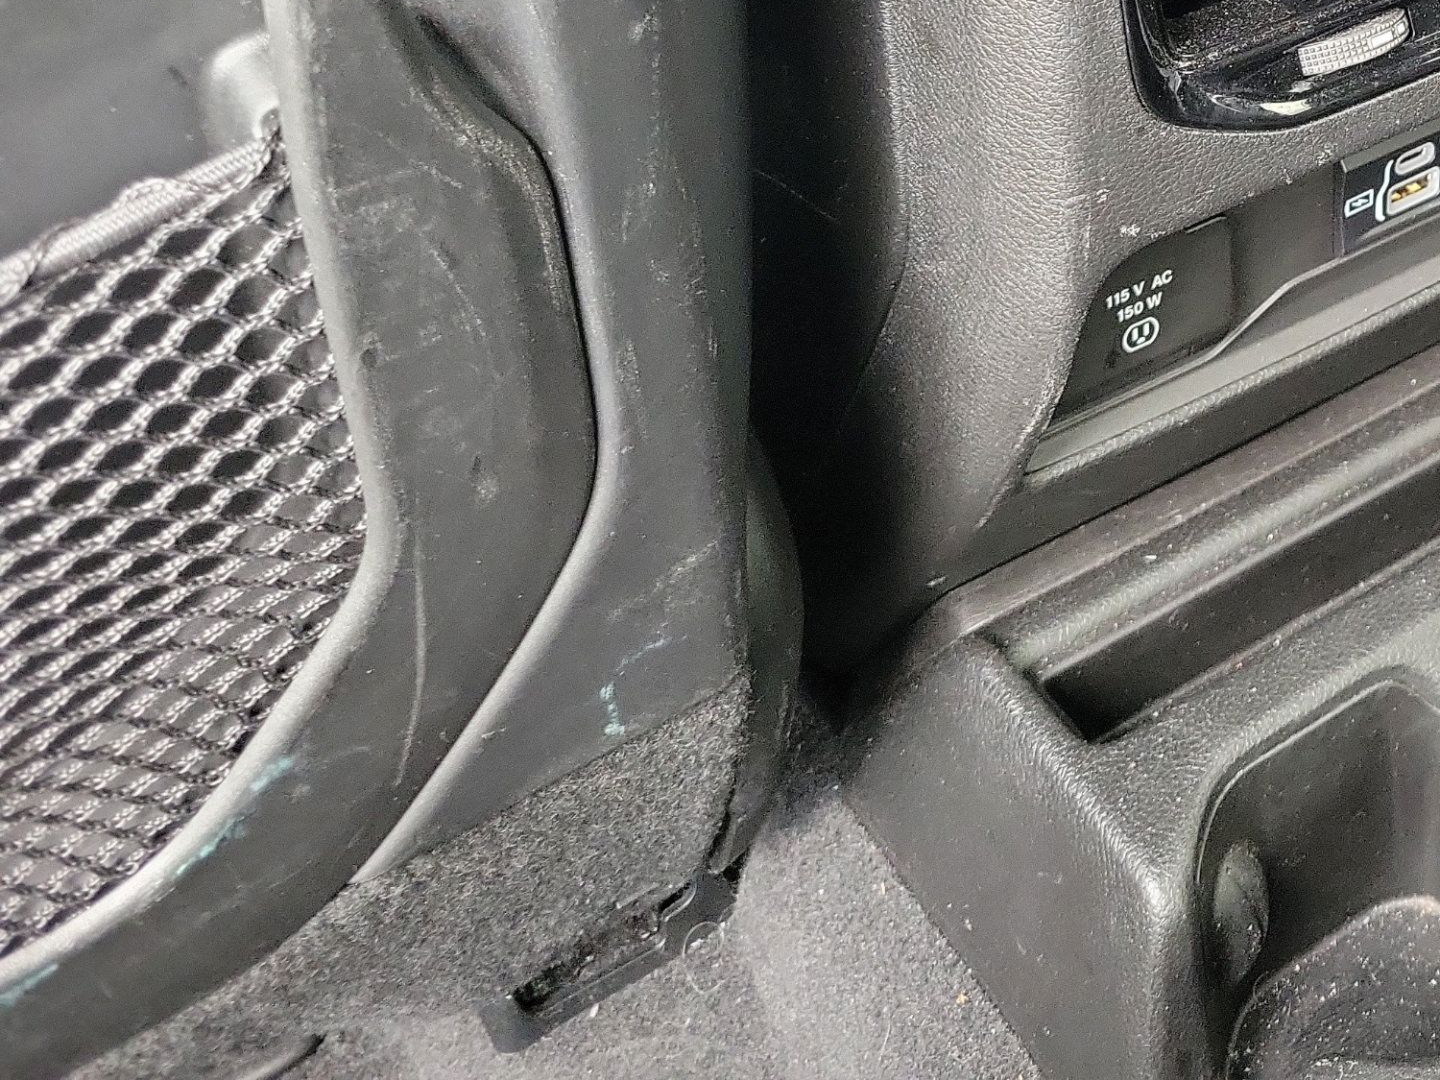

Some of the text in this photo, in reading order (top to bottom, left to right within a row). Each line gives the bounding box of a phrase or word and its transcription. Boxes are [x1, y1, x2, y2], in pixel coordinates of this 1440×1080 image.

[1105, 269, 1173, 310] 115 V AC
[1116, 291, 1163, 323] 150 W
